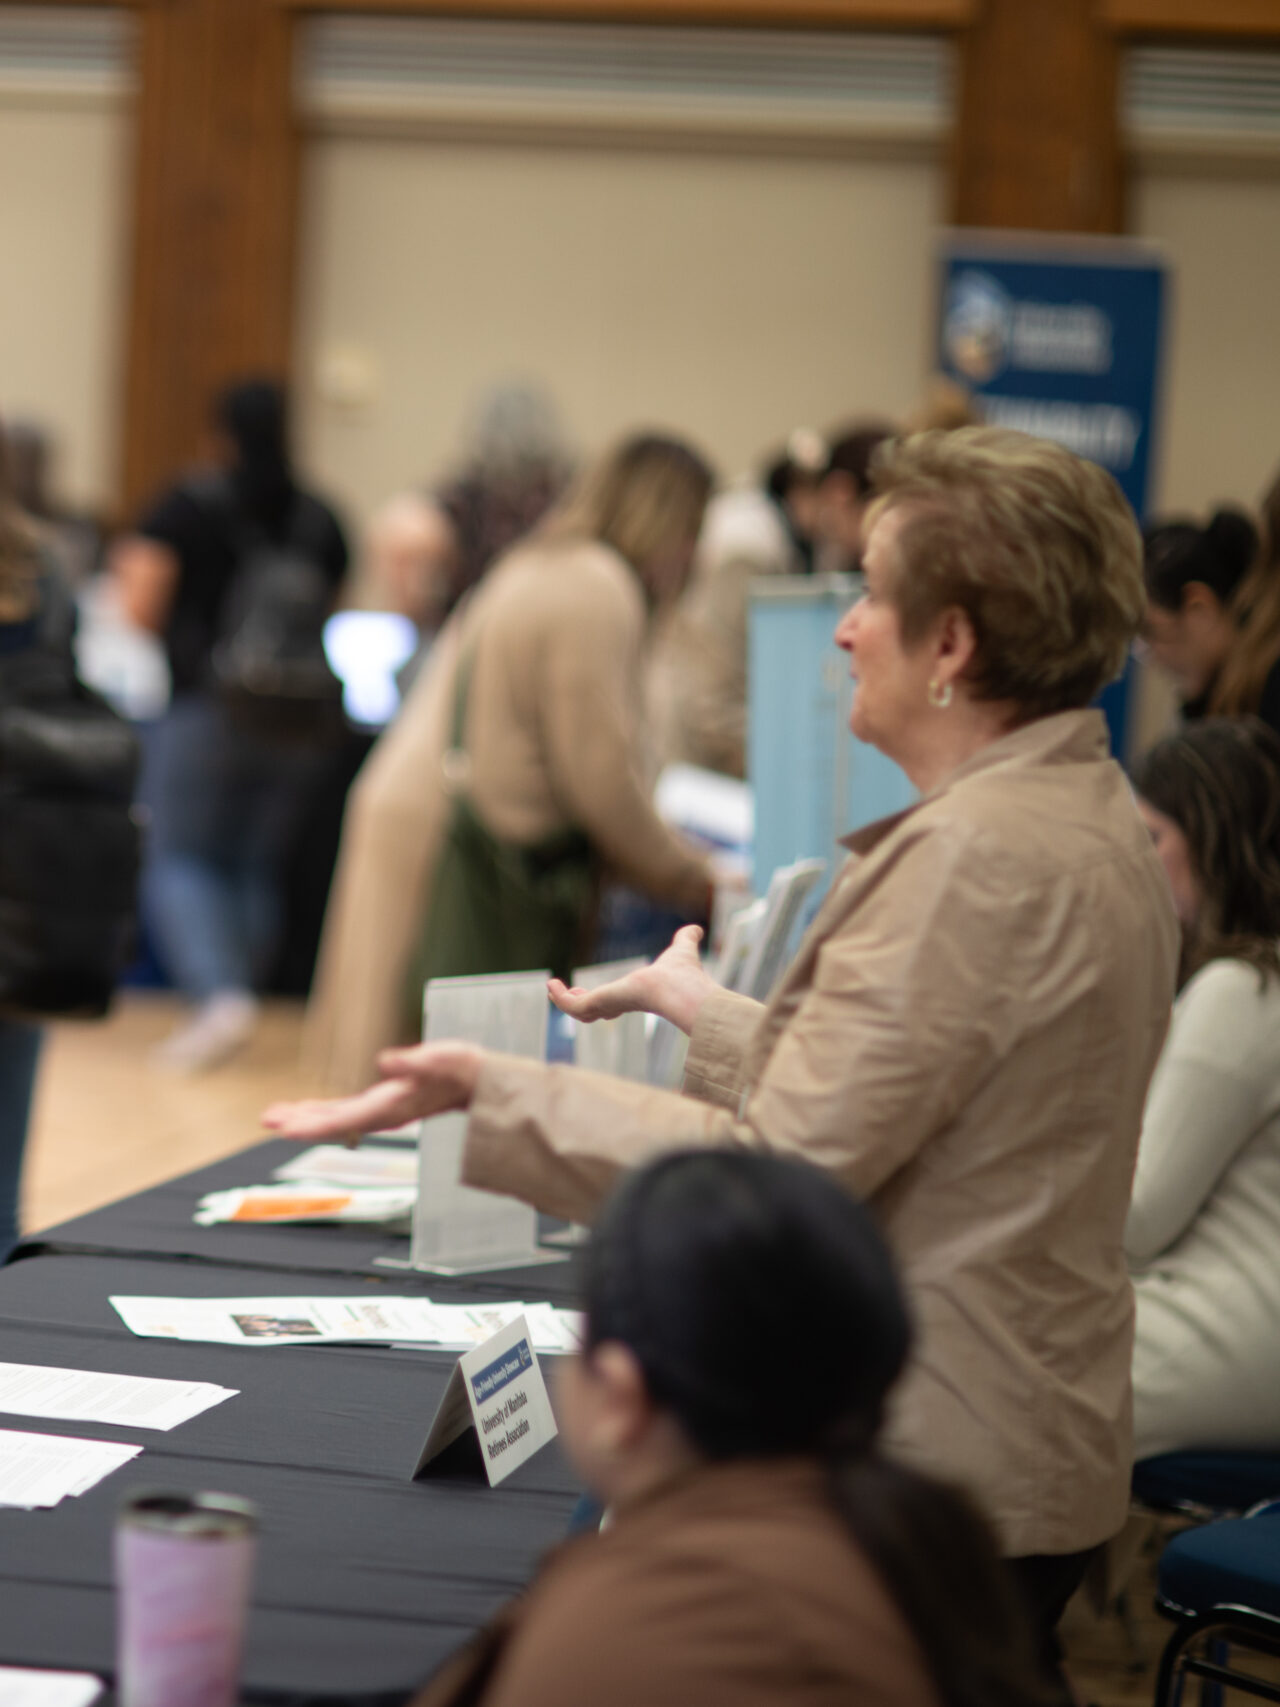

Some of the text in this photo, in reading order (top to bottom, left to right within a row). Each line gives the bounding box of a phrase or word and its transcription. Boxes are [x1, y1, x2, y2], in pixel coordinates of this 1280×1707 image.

[482, 1390, 528, 1435] University of Manitoba
[487, 1419, 531, 1461] Retirees Association
